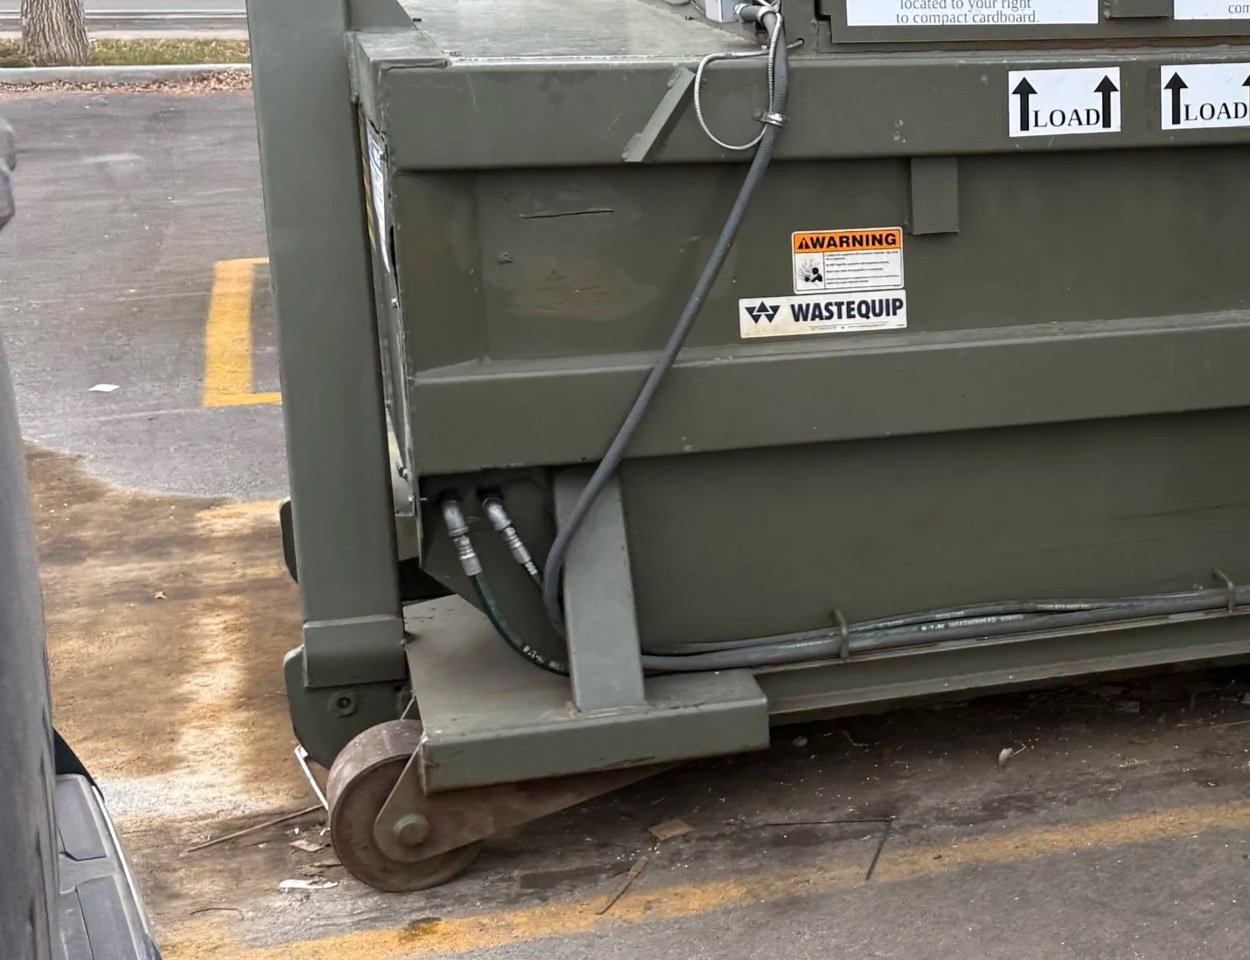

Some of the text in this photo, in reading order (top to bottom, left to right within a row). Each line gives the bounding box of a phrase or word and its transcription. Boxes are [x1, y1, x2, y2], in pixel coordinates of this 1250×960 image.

[968, 0, 997, 13] your
[896, 10, 1039, 25] to compact cardboard.
[1033, 107, 1100, 128] LOAD
[1183, 101, 1247, 121] LOAD
[810, 233, 896, 249] WARNING
[791, 298, 903, 323] WASTEQUIP
